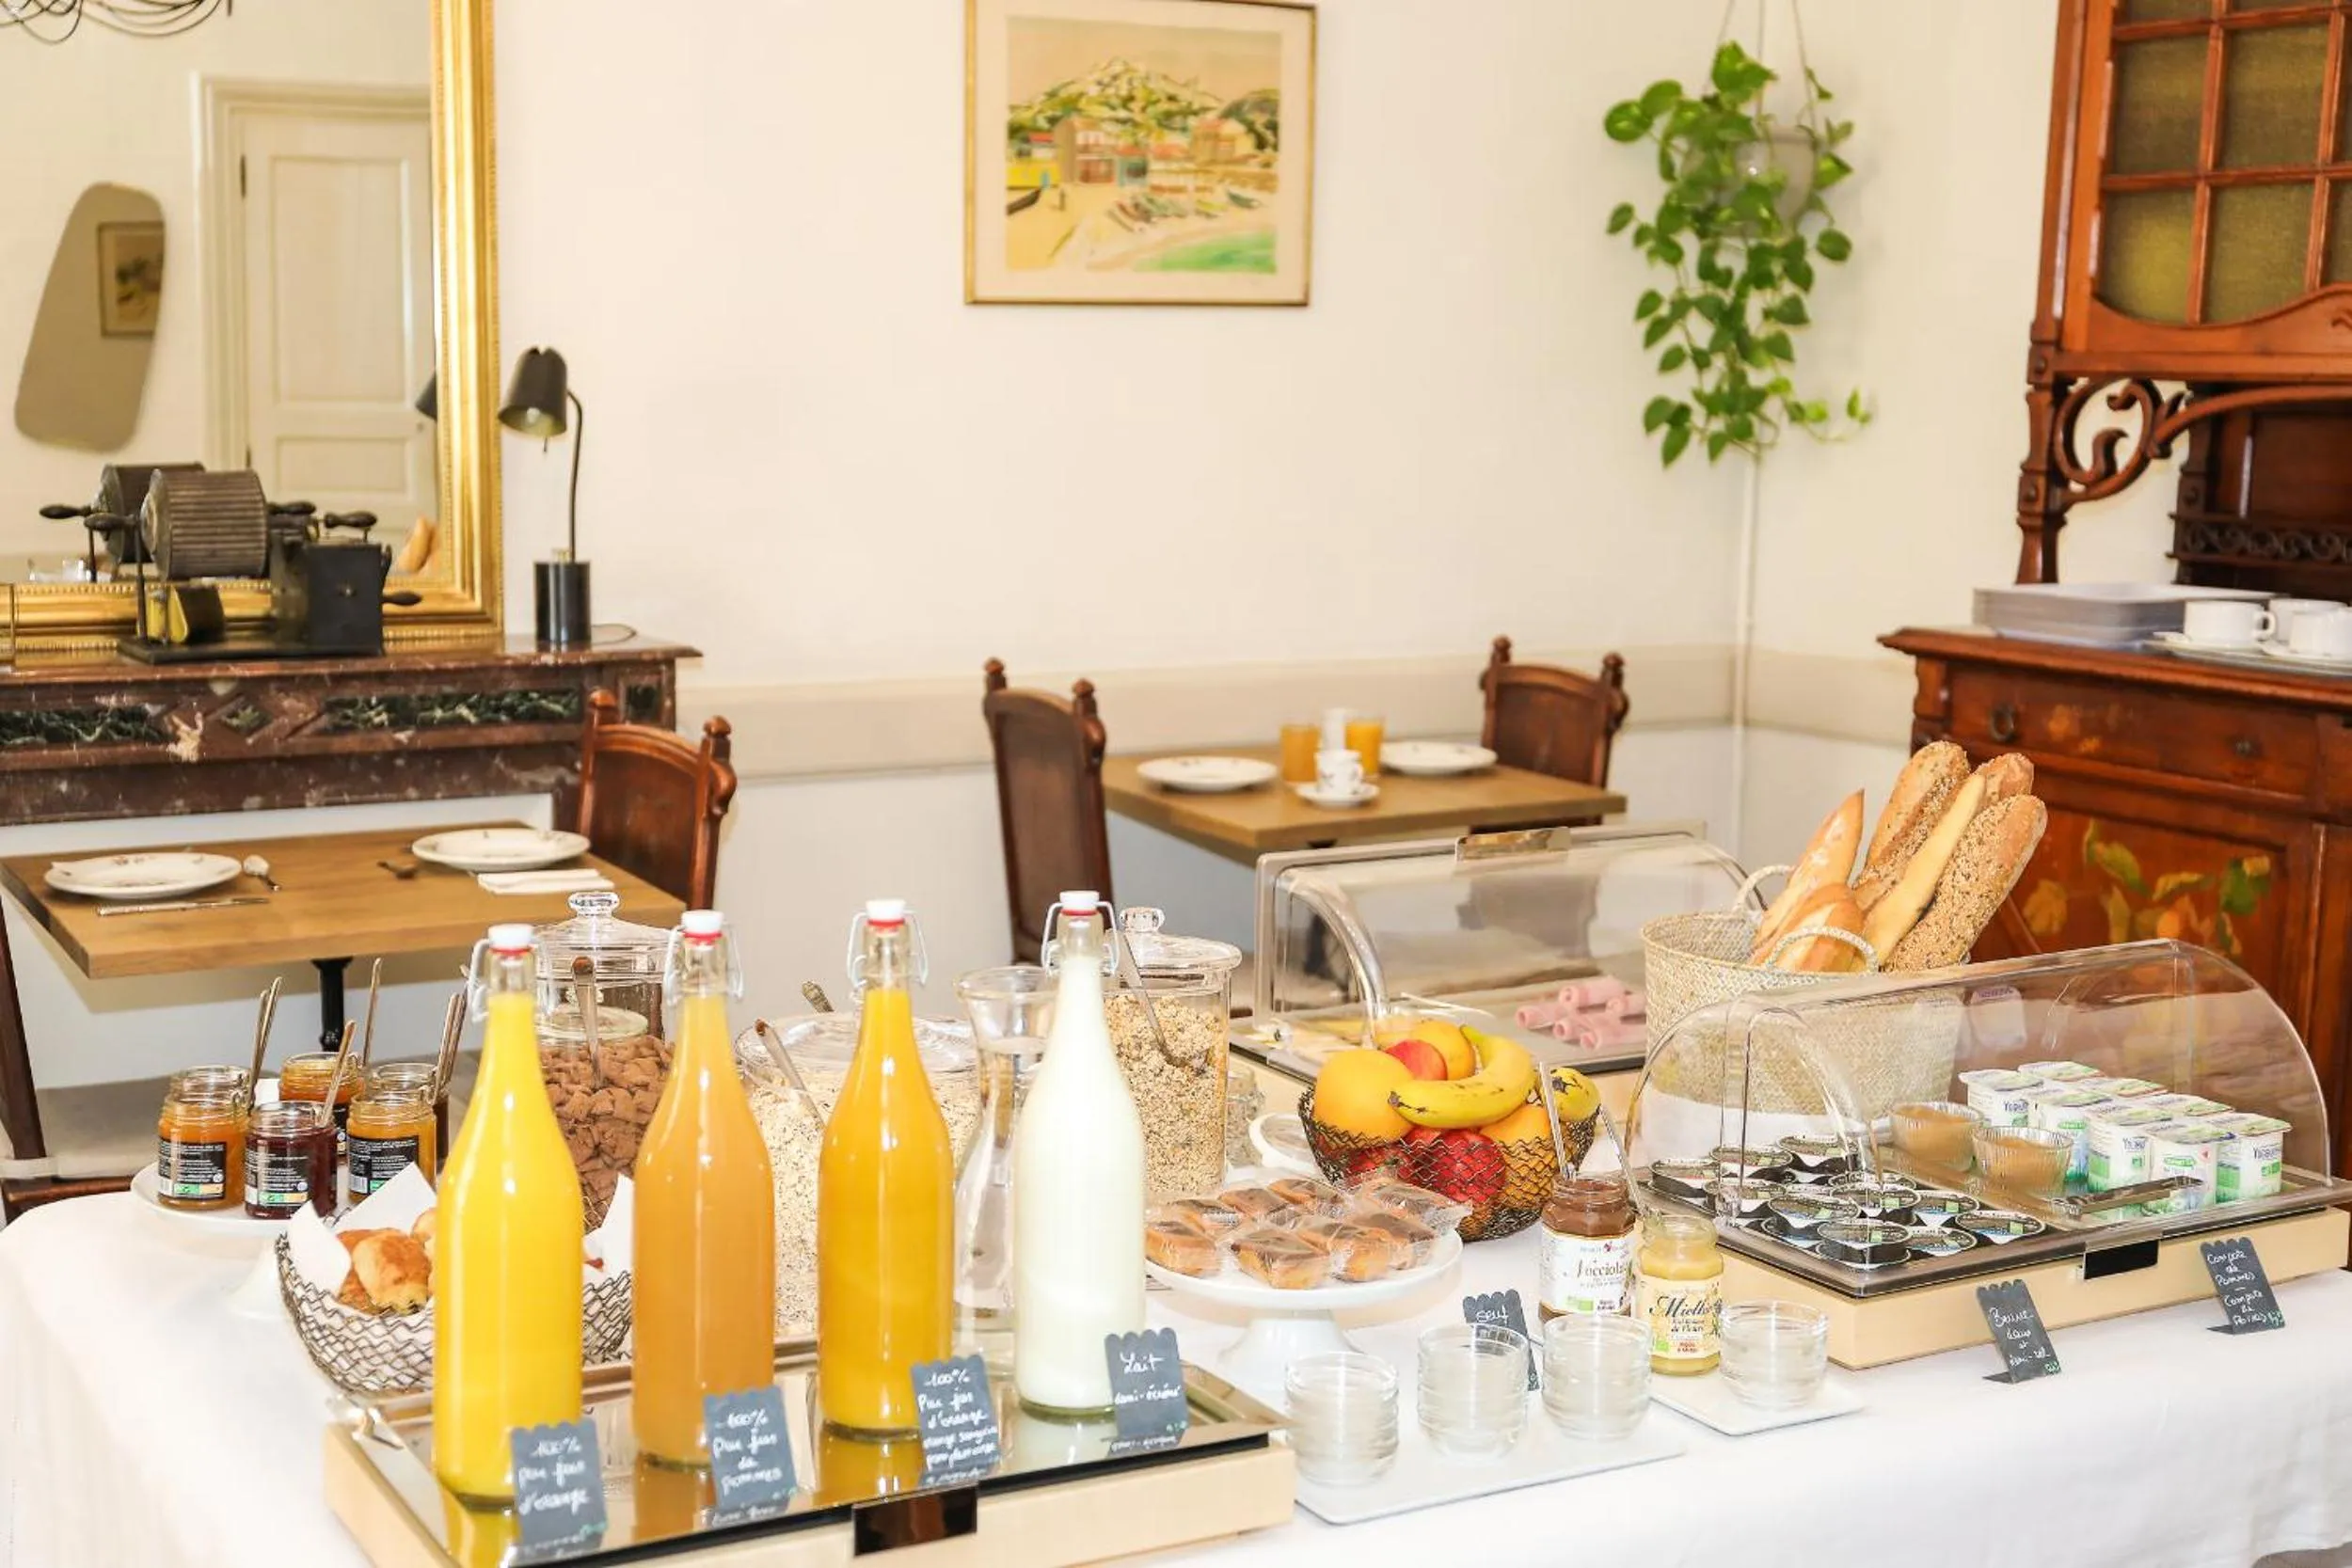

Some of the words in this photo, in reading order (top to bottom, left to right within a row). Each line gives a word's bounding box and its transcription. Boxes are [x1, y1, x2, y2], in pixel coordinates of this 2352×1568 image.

[1120, 1353, 1166, 1373] Lait
[924, 1368, 970, 1386] 100%
[715, 1408, 770, 1429] 100%
